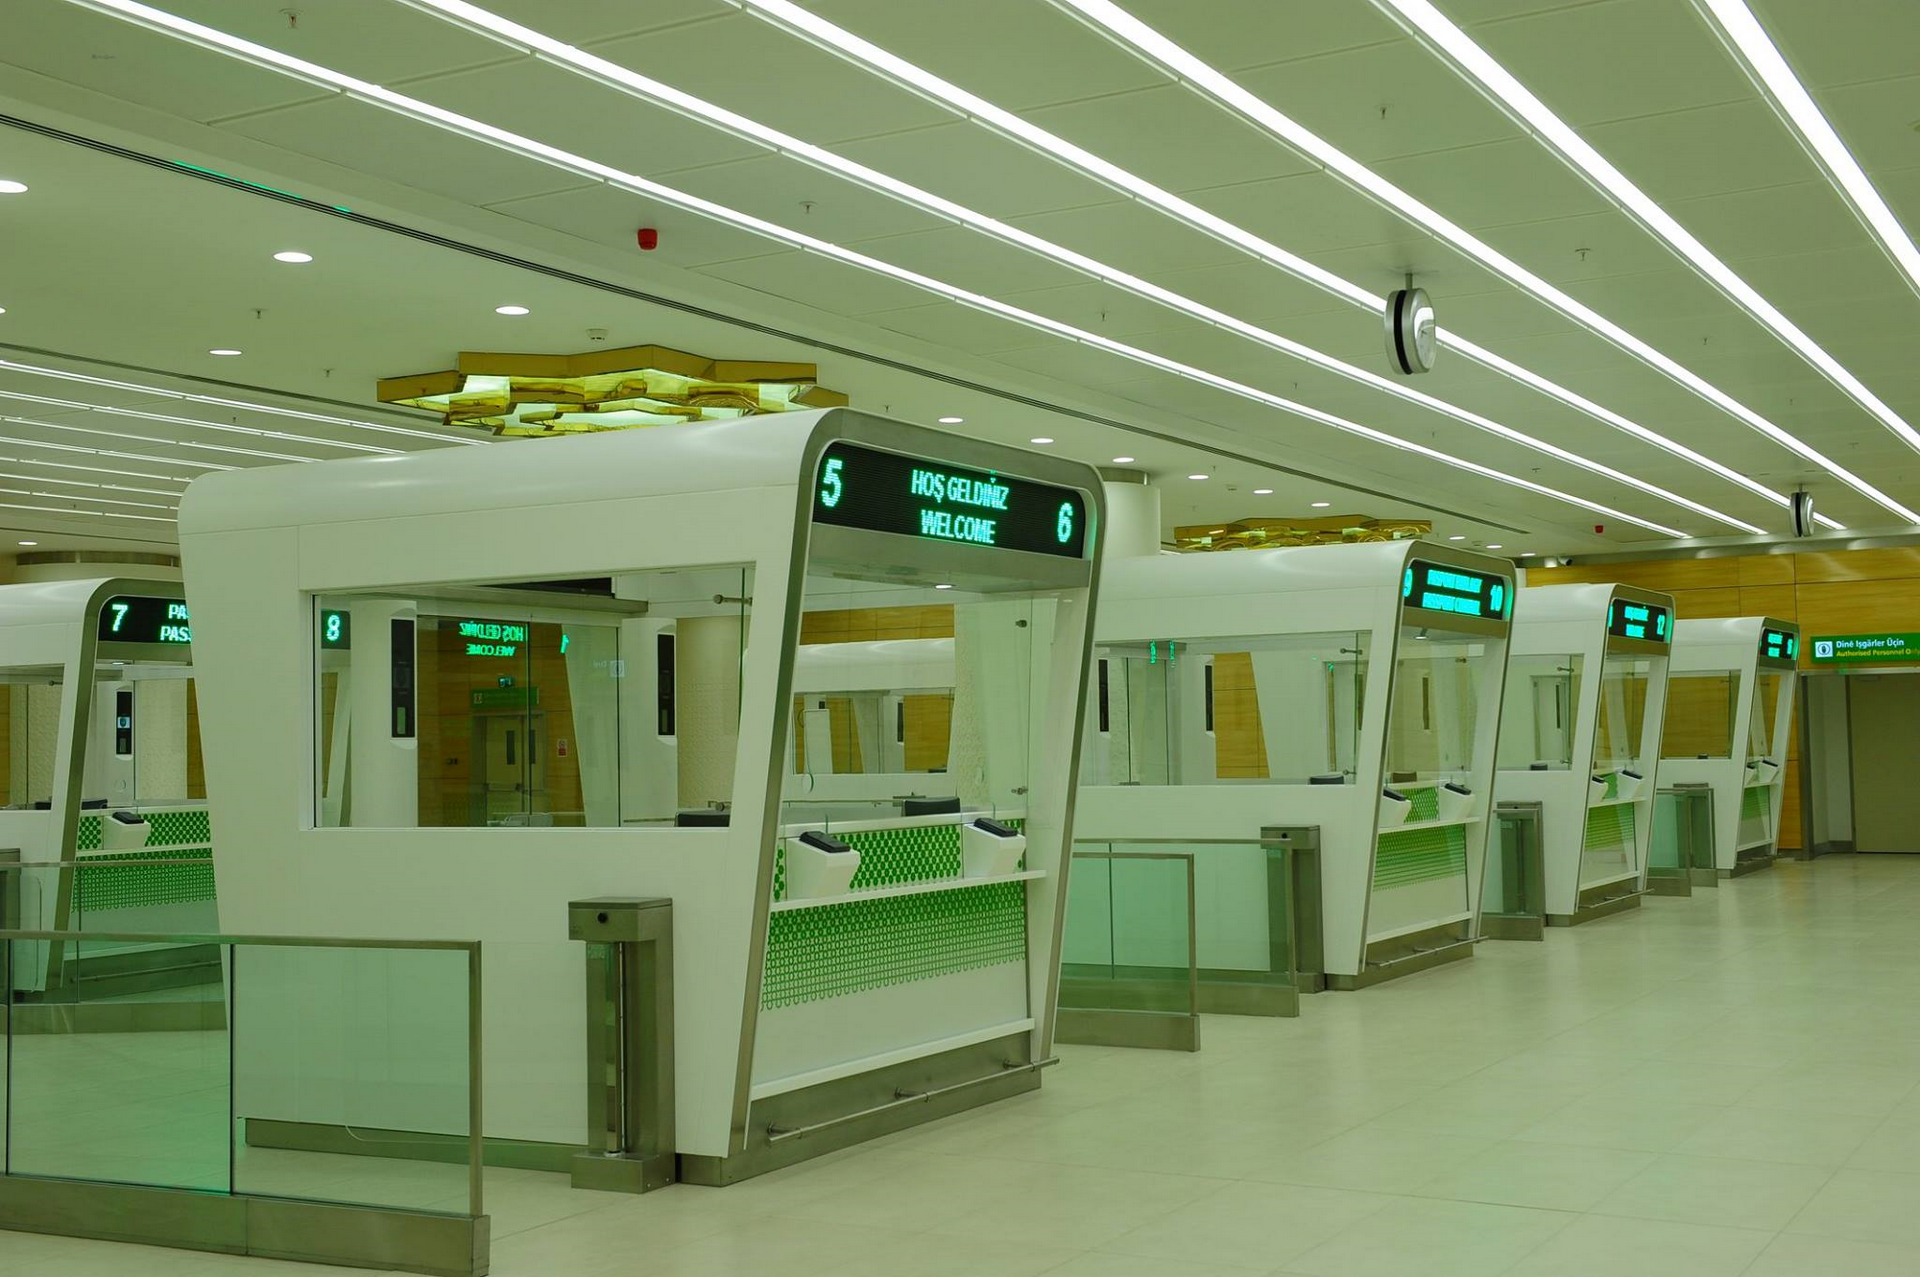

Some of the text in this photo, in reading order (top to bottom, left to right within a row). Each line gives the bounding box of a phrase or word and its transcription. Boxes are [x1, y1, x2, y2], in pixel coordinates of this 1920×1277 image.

[821, 459, 843, 507] 5
[911, 469, 946, 503] HOŞ
[921, 509, 996, 544] WELCOME
[1056, 502, 1074, 543] 6
[1490, 584, 1504, 611] 10
[112, 604, 129, 632] 7
[168, 604, 188, 620] PA
[160, 625, 191, 642] PAS
[326, 614, 341, 641] 8
[1872, 648, 1904, 656] Personnel
